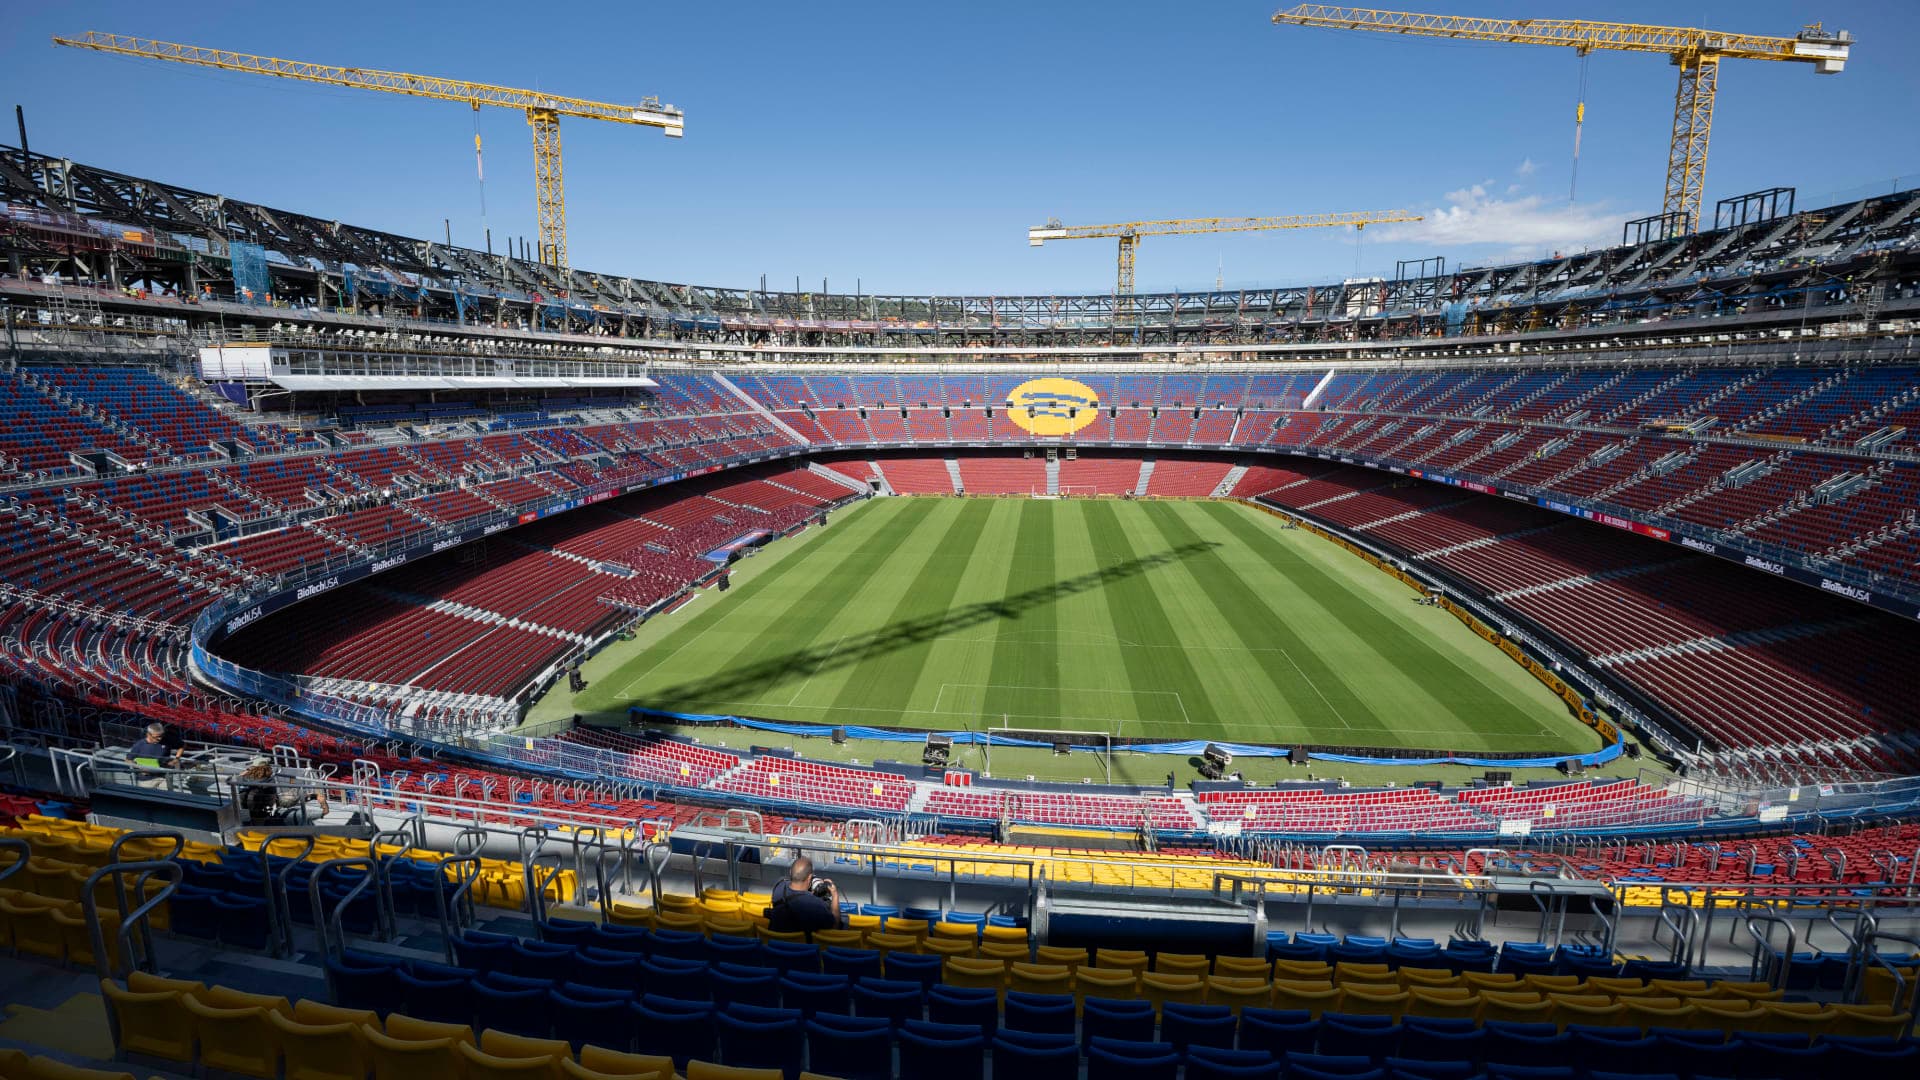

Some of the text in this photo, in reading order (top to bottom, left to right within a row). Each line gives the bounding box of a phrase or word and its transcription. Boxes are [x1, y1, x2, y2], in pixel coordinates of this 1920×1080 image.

[372, 553, 407, 573] BioTechUSA
[1745, 555, 1785, 576] BioTechUSA
[297, 576, 339, 600] BioTechUSA
[1821, 578, 1871, 603] BioTechUSA
